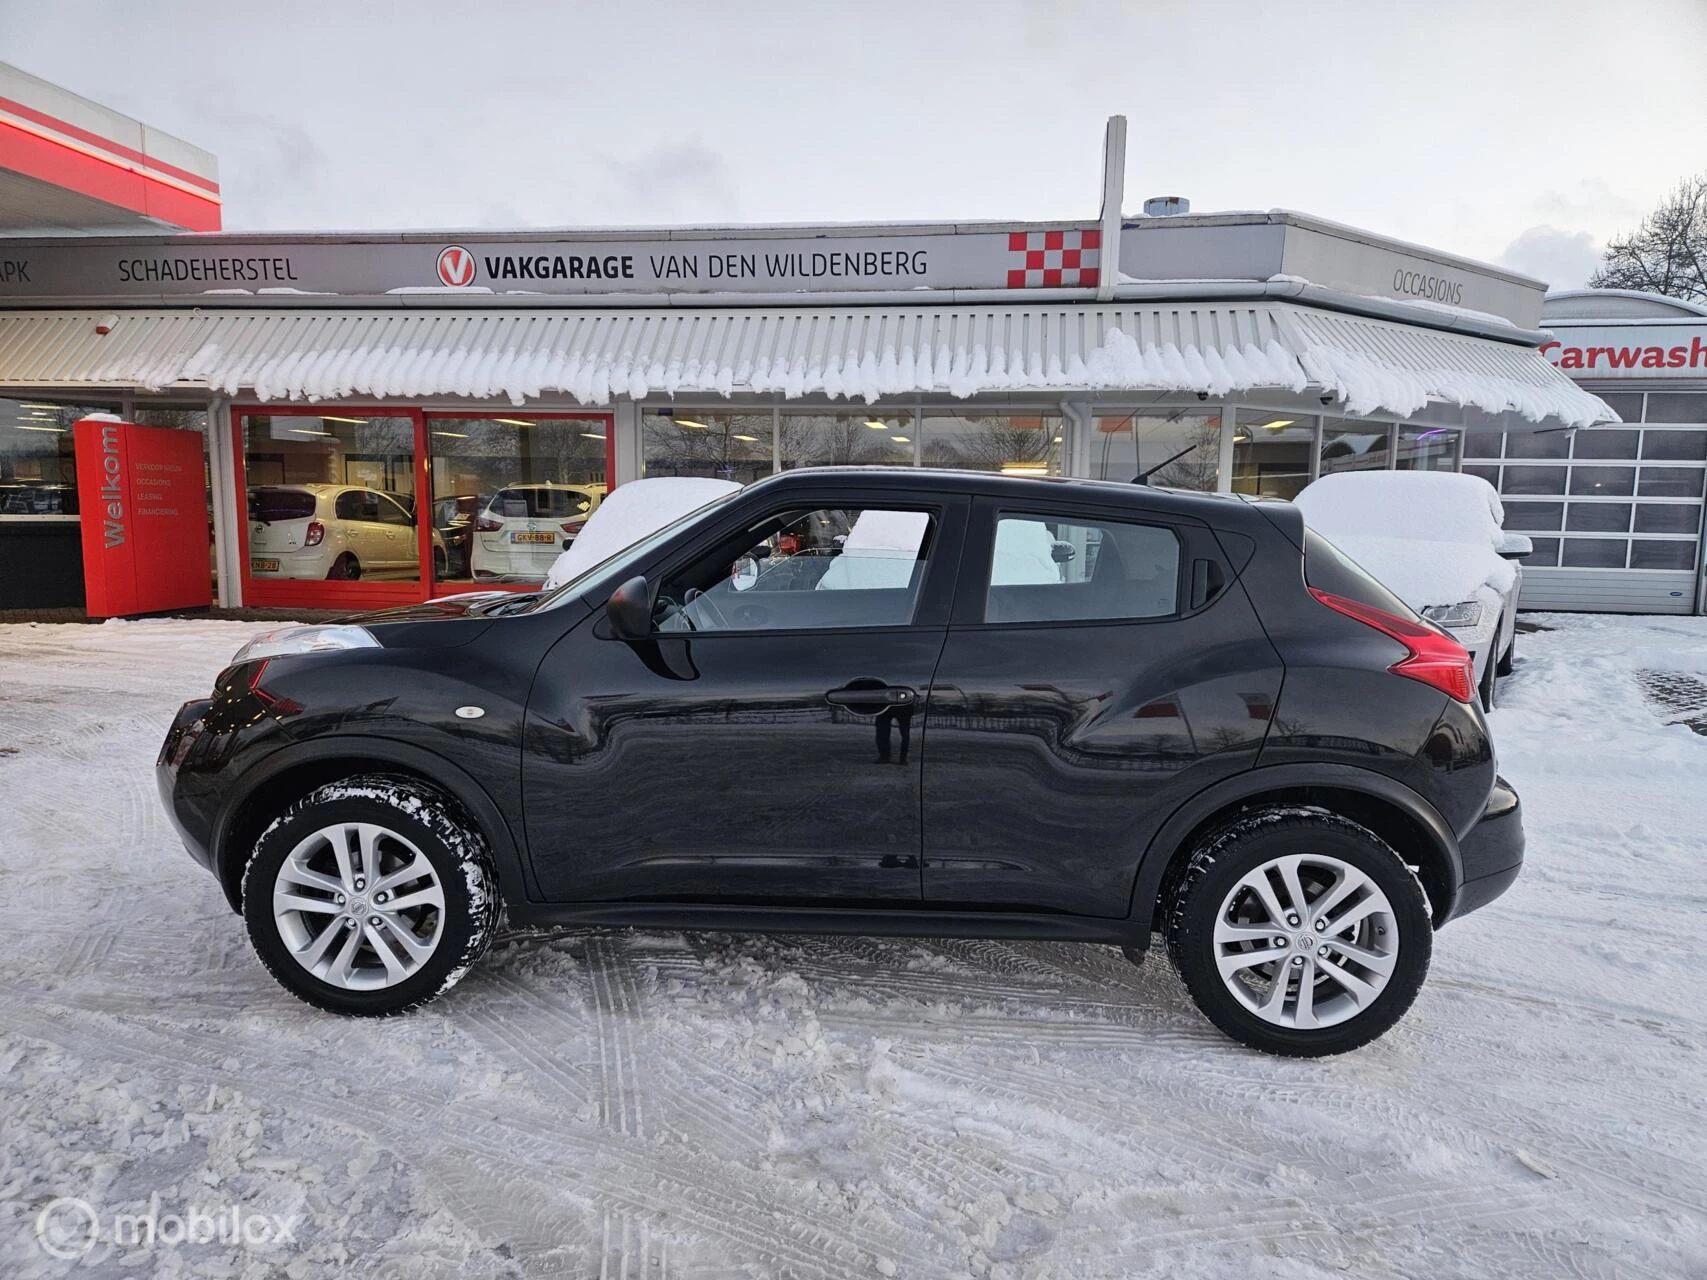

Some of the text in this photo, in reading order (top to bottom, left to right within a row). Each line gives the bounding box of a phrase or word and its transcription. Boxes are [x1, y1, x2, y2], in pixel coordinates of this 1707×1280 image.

[118, 258, 298, 282] SCHADEHERSTEL
[485, 250, 928, 280] VAKGARAGE VAN DEN WILDENBERG
[1392, 268, 1464, 305] OCCASIONS
[1539, 336, 1707, 369] Carwash
[101, 426, 125, 549] Welkom
[136, 478, 171, 486] OCCASIONS
